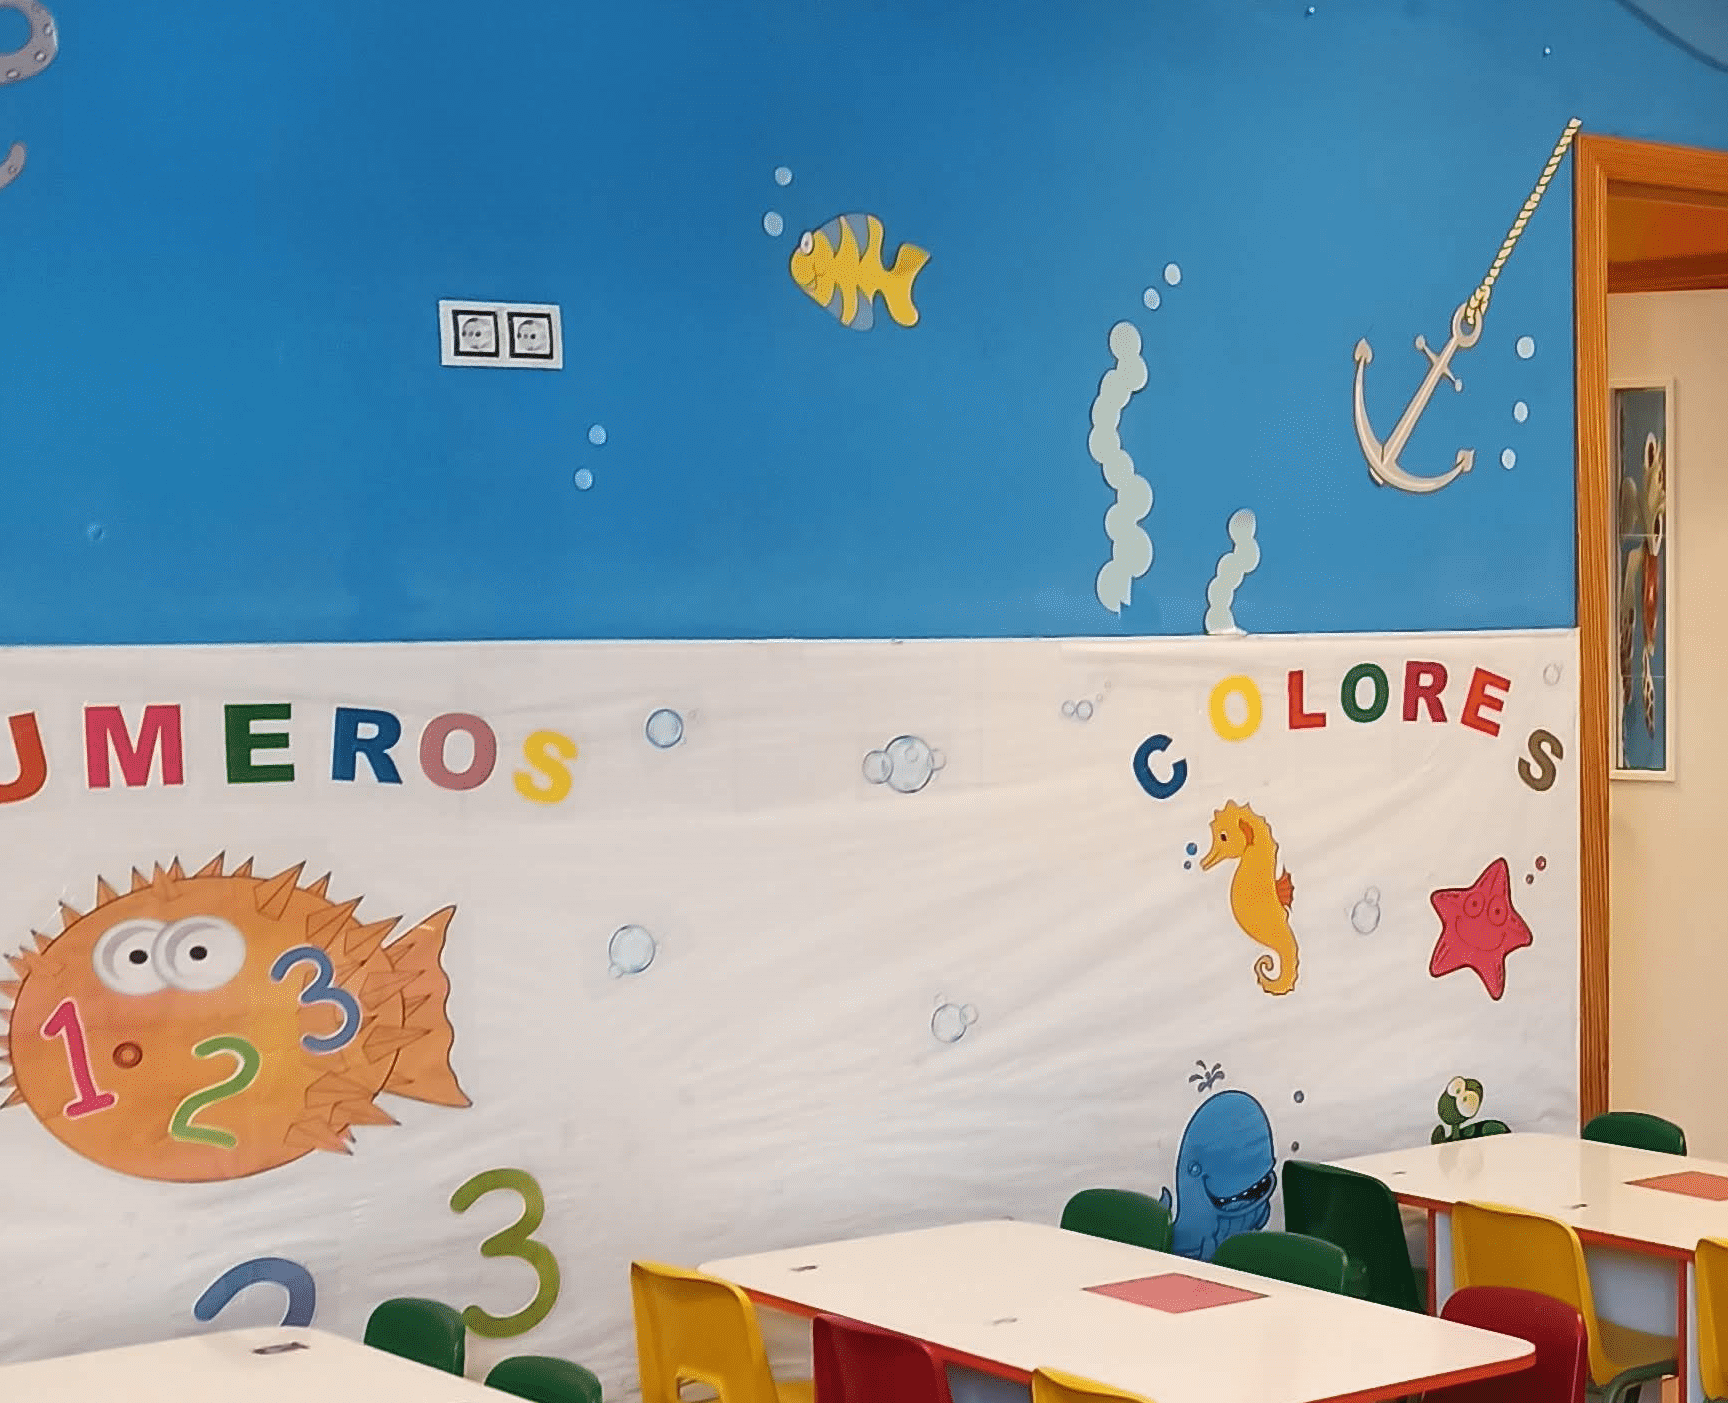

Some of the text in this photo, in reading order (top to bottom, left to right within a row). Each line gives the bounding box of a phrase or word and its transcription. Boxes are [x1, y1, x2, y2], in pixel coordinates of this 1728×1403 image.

[1133, 661, 1564, 799] COLORES
[42, 946, 362, 1148] 1 2 3
[450, 1168, 562, 1339] 3
